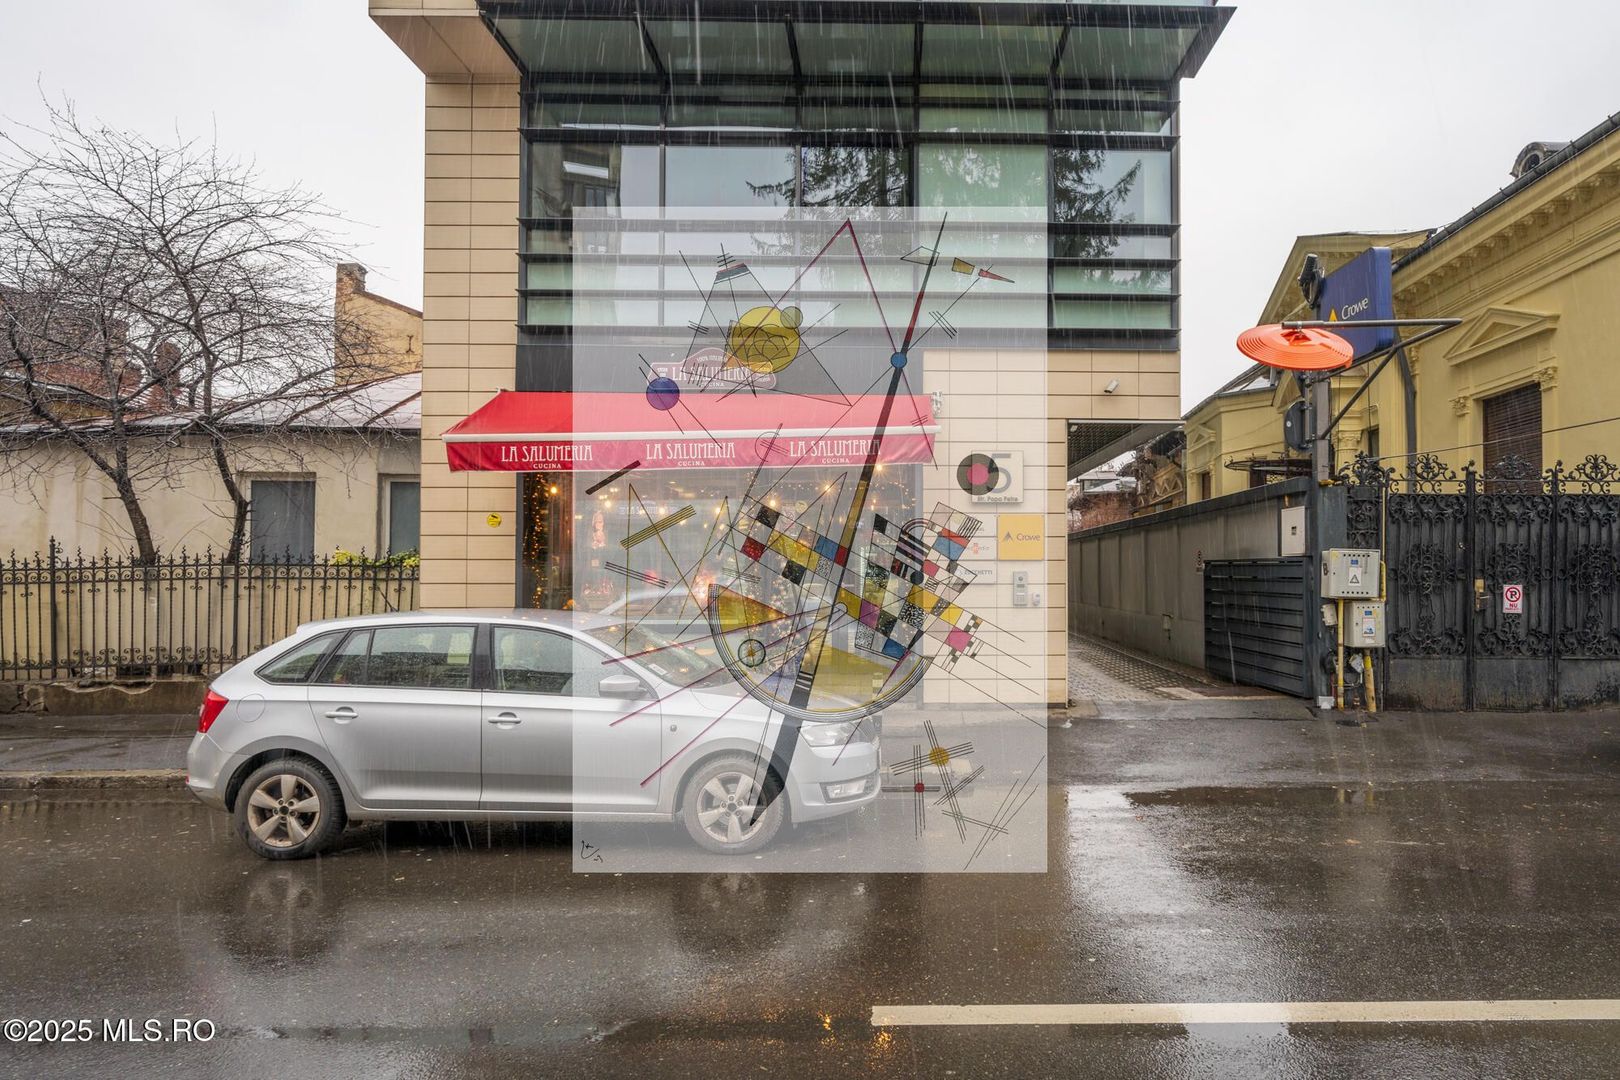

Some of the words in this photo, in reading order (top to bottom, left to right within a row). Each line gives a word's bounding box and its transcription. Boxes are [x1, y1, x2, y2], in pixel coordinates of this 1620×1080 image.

[1341, 298, 1369, 320] Crowe
[672, 366, 687, 381] LA
[501, 446, 519, 462] LA
[521, 445, 593, 462] SALUMERIA
[646, 443, 663, 460] LA
[666, 442, 736, 459] SALUMERIA
[790, 441, 807, 457] LA
[810, 439, 881, 457] SALUMERIA
[1016, 532, 1041, 542] Crowe
